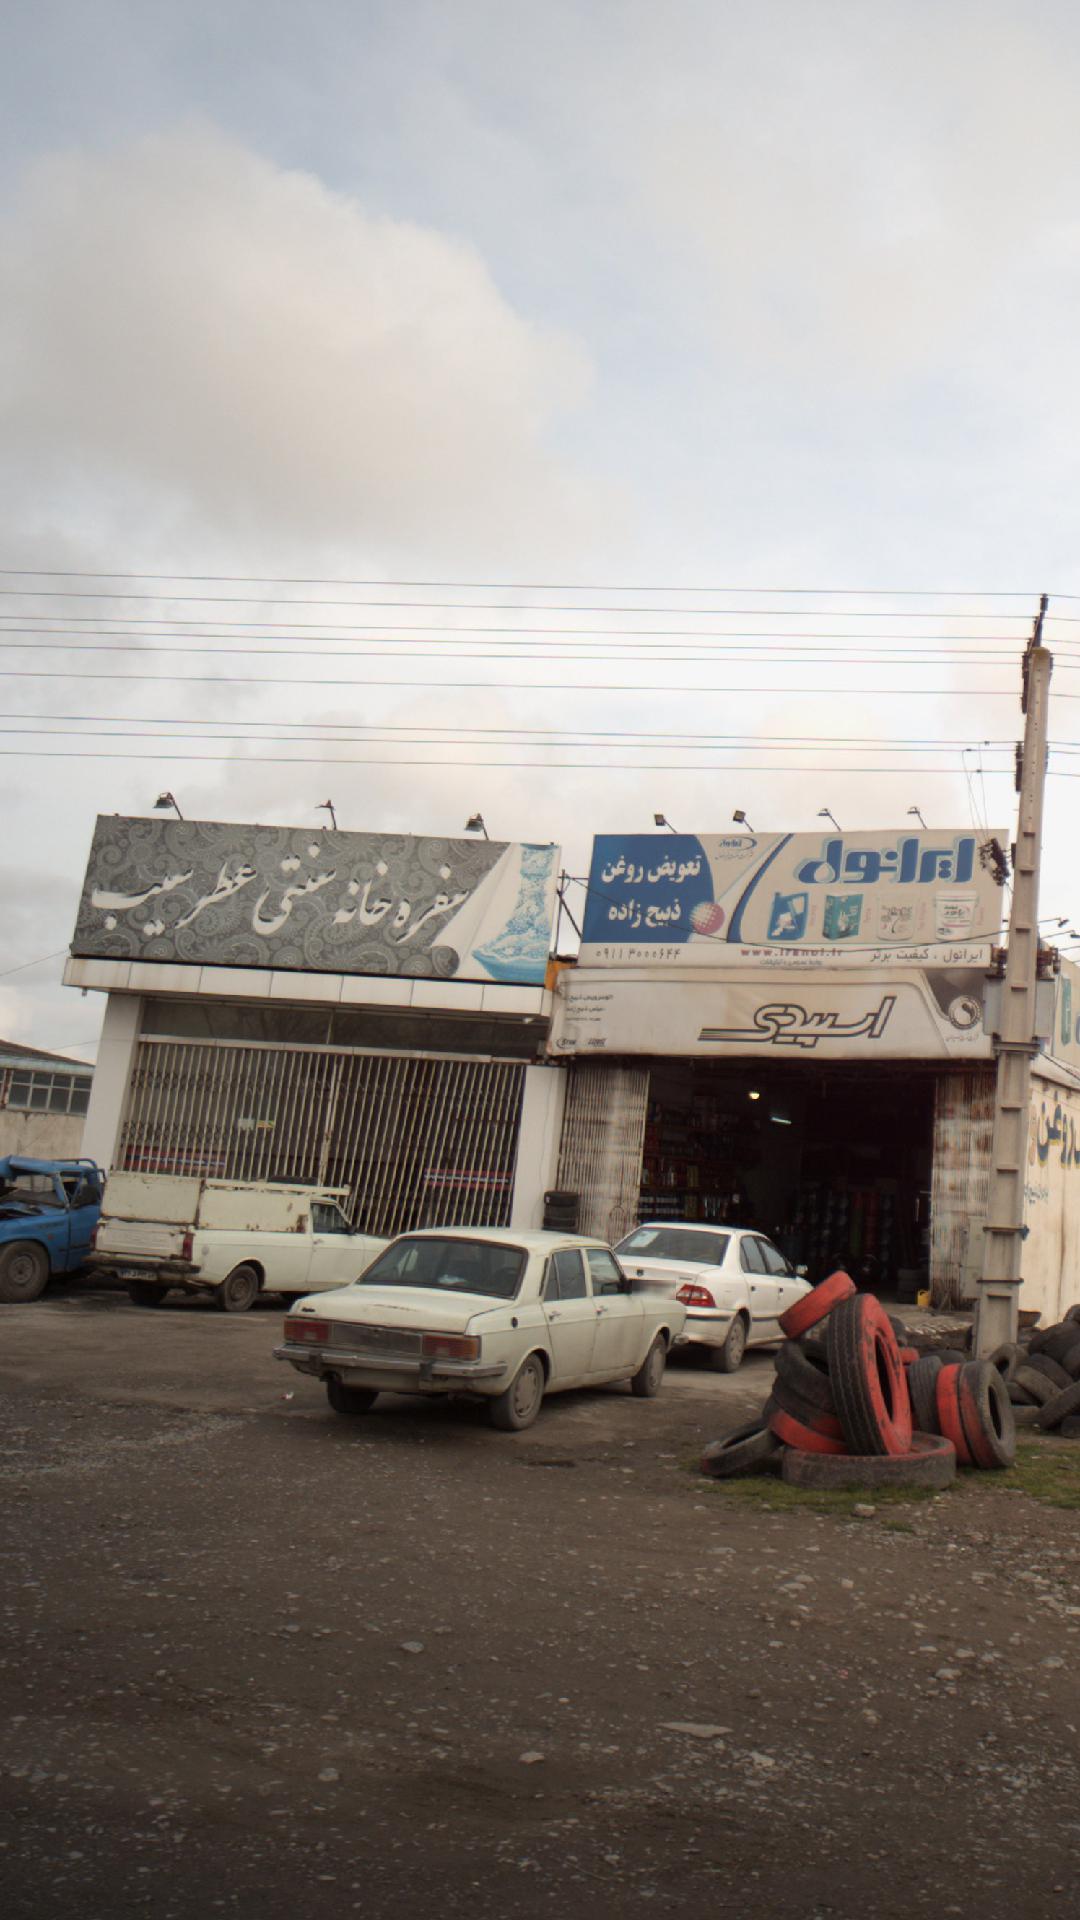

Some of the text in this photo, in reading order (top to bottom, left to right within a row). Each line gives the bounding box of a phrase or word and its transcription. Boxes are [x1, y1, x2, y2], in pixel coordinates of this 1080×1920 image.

[601, 855, 702, 884] تعویض روغن
[798, 838, 976, 884] ایرانول
[91, 844, 469, 943] سفره خانه سنتی عطر سیب
[608, 898, 682, 929] ذبیح زاده
[870, 949, 893, 963] برتر
[896, 947, 930, 962] کیفیت
[943, 948, 983, 963] ایرانول
